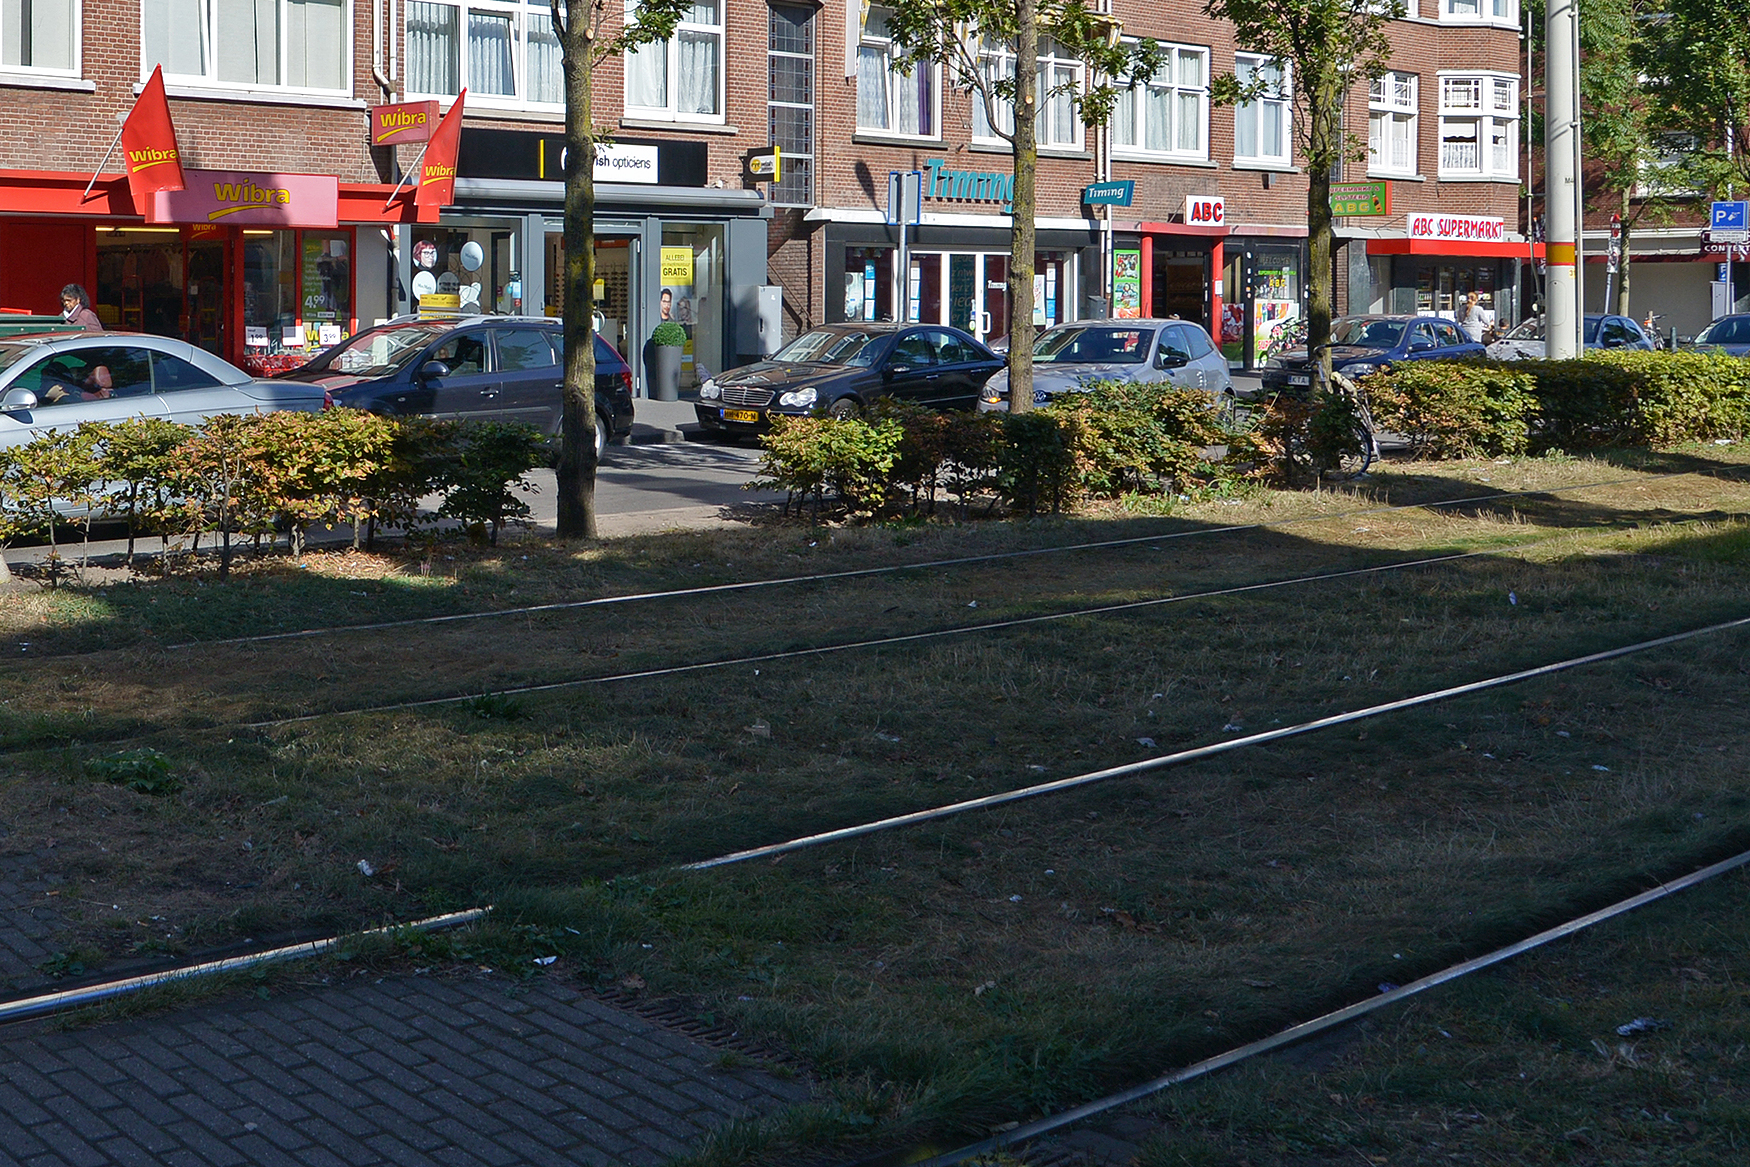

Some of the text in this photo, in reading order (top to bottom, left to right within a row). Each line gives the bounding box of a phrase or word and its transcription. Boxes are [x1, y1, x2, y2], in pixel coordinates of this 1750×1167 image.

[380, 108, 427, 128] Wibra
[129, 146, 178, 163] Wibra
[612, 155, 651, 170] opticiens
[425, 162, 455, 177] Wibra
[213, 177, 290, 204] Wibra
[1088, 185, 1125, 199] Timing
[1191, 201, 1223, 223] ABC
[1412, 217, 1505, 239] ABC SUPERMARKT
[662, 267, 688, 276] GRATIS
